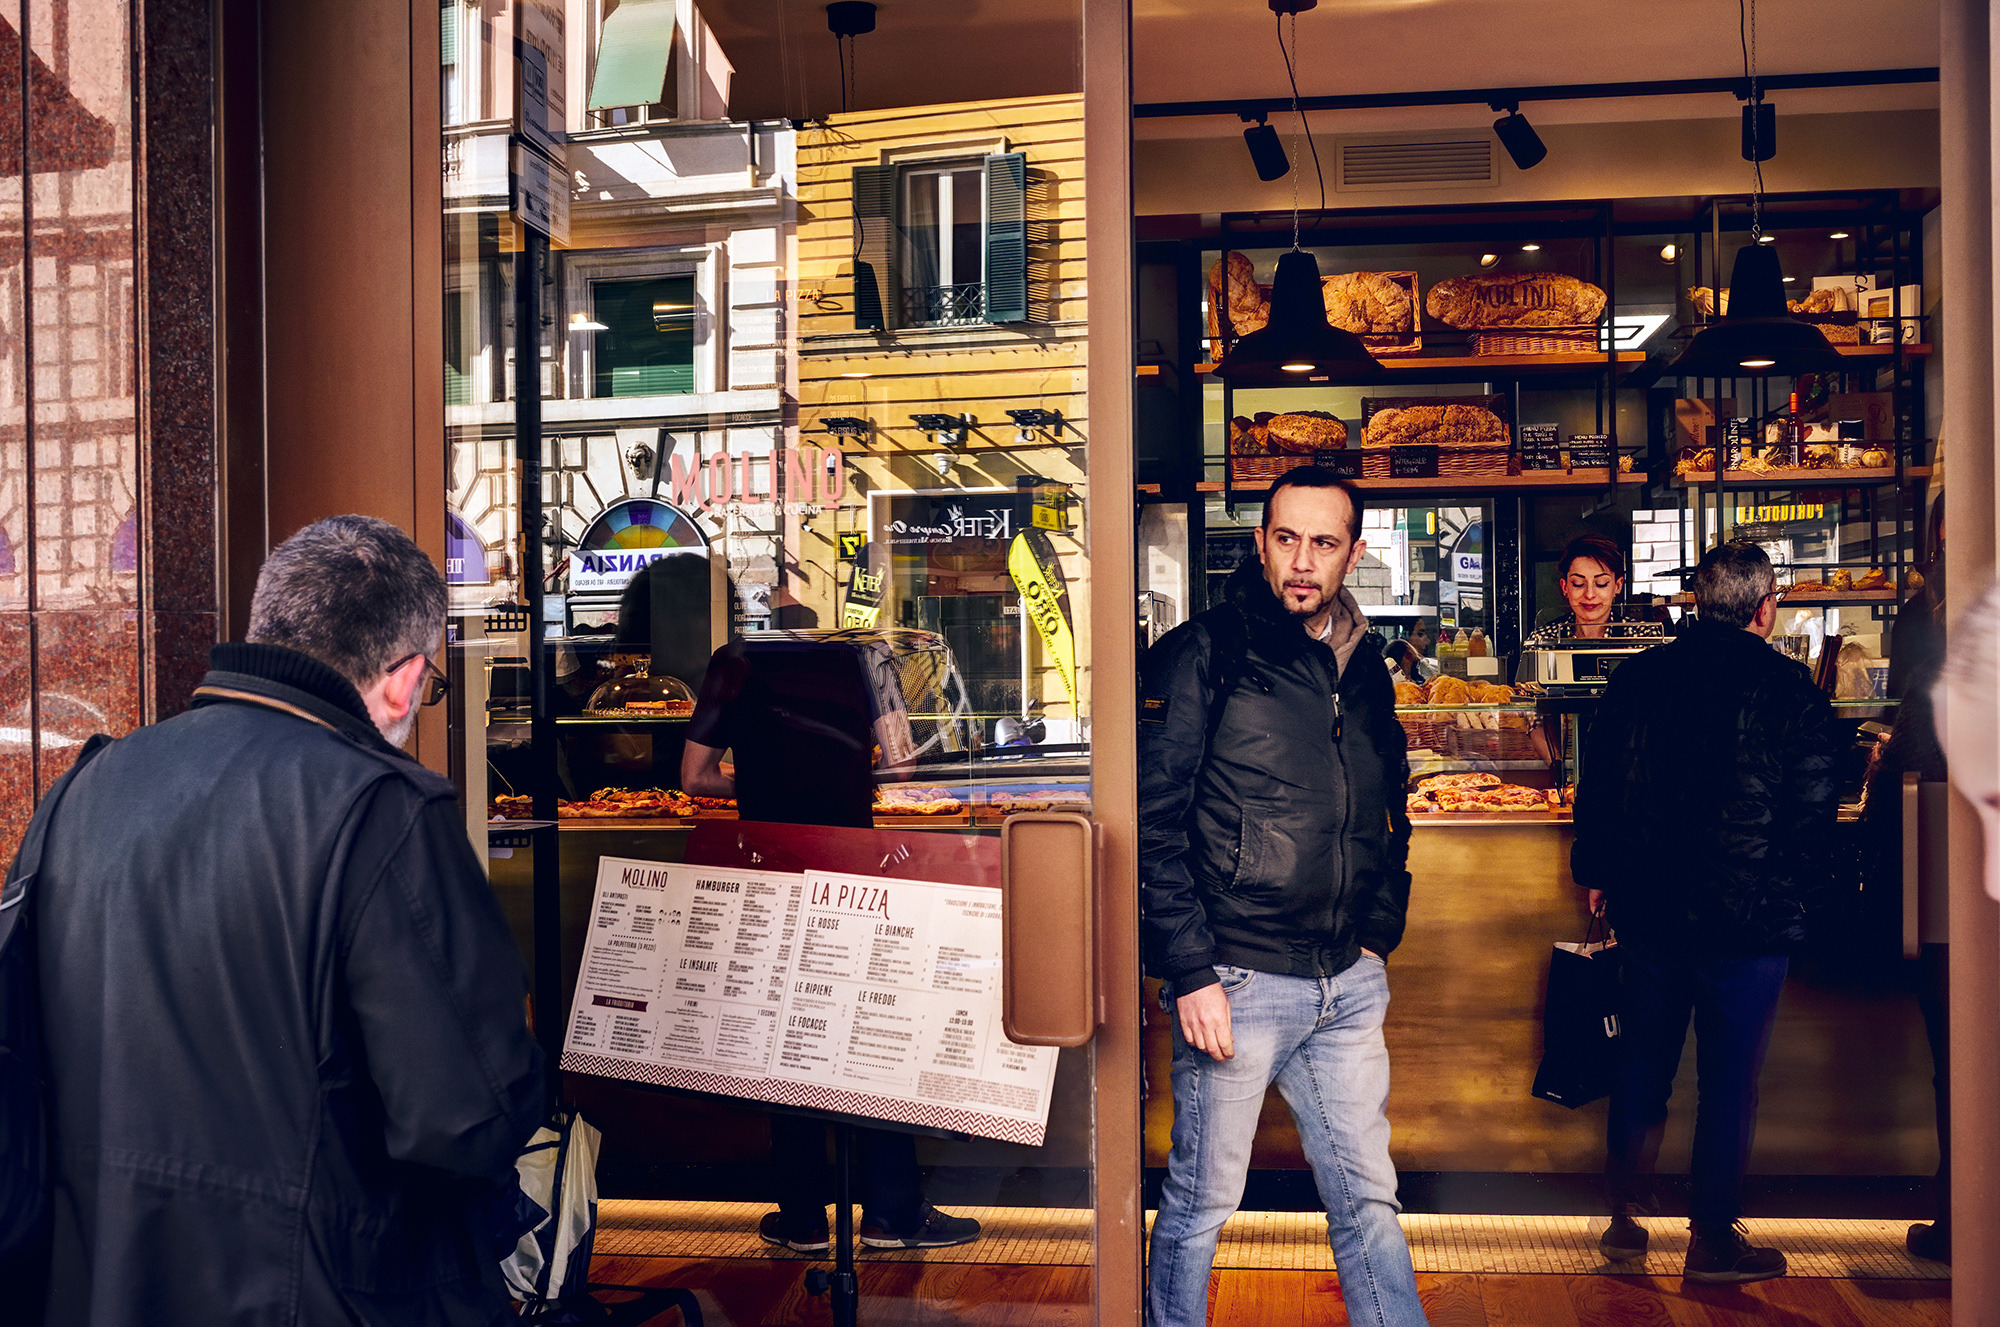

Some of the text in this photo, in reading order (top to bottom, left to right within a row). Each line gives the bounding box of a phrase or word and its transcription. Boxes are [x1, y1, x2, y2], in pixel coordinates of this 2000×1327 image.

[785, 288, 821, 301] PIZZA
[671, 447, 843, 512] MOLINO
[853, 566, 882, 593] KETER
[621, 867, 669, 890] MOLINO
[695, 879, 740, 894] HAMBURGER
[609, 892, 628, 900] ANTIPASTI
[811, 882, 890, 921] LA PIZZA
[806, 916, 840, 931] LE ROSSE
[874, 923, 915, 939] LE BIANCHE
[613, 940, 637, 949] POLPETTERIA
[679, 958, 719, 973] LE INSALATE
[794, 981, 833, 997] LE RIPIENE
[687, 1000, 699, 1008] PRIMI
[857, 990, 897, 1007] LE FREDDE
[760, 1009, 777, 1018] SECONDI
[955, 1009, 969, 1017] LUNCH
[788, 1015, 828, 1032] LE FOCACCE
